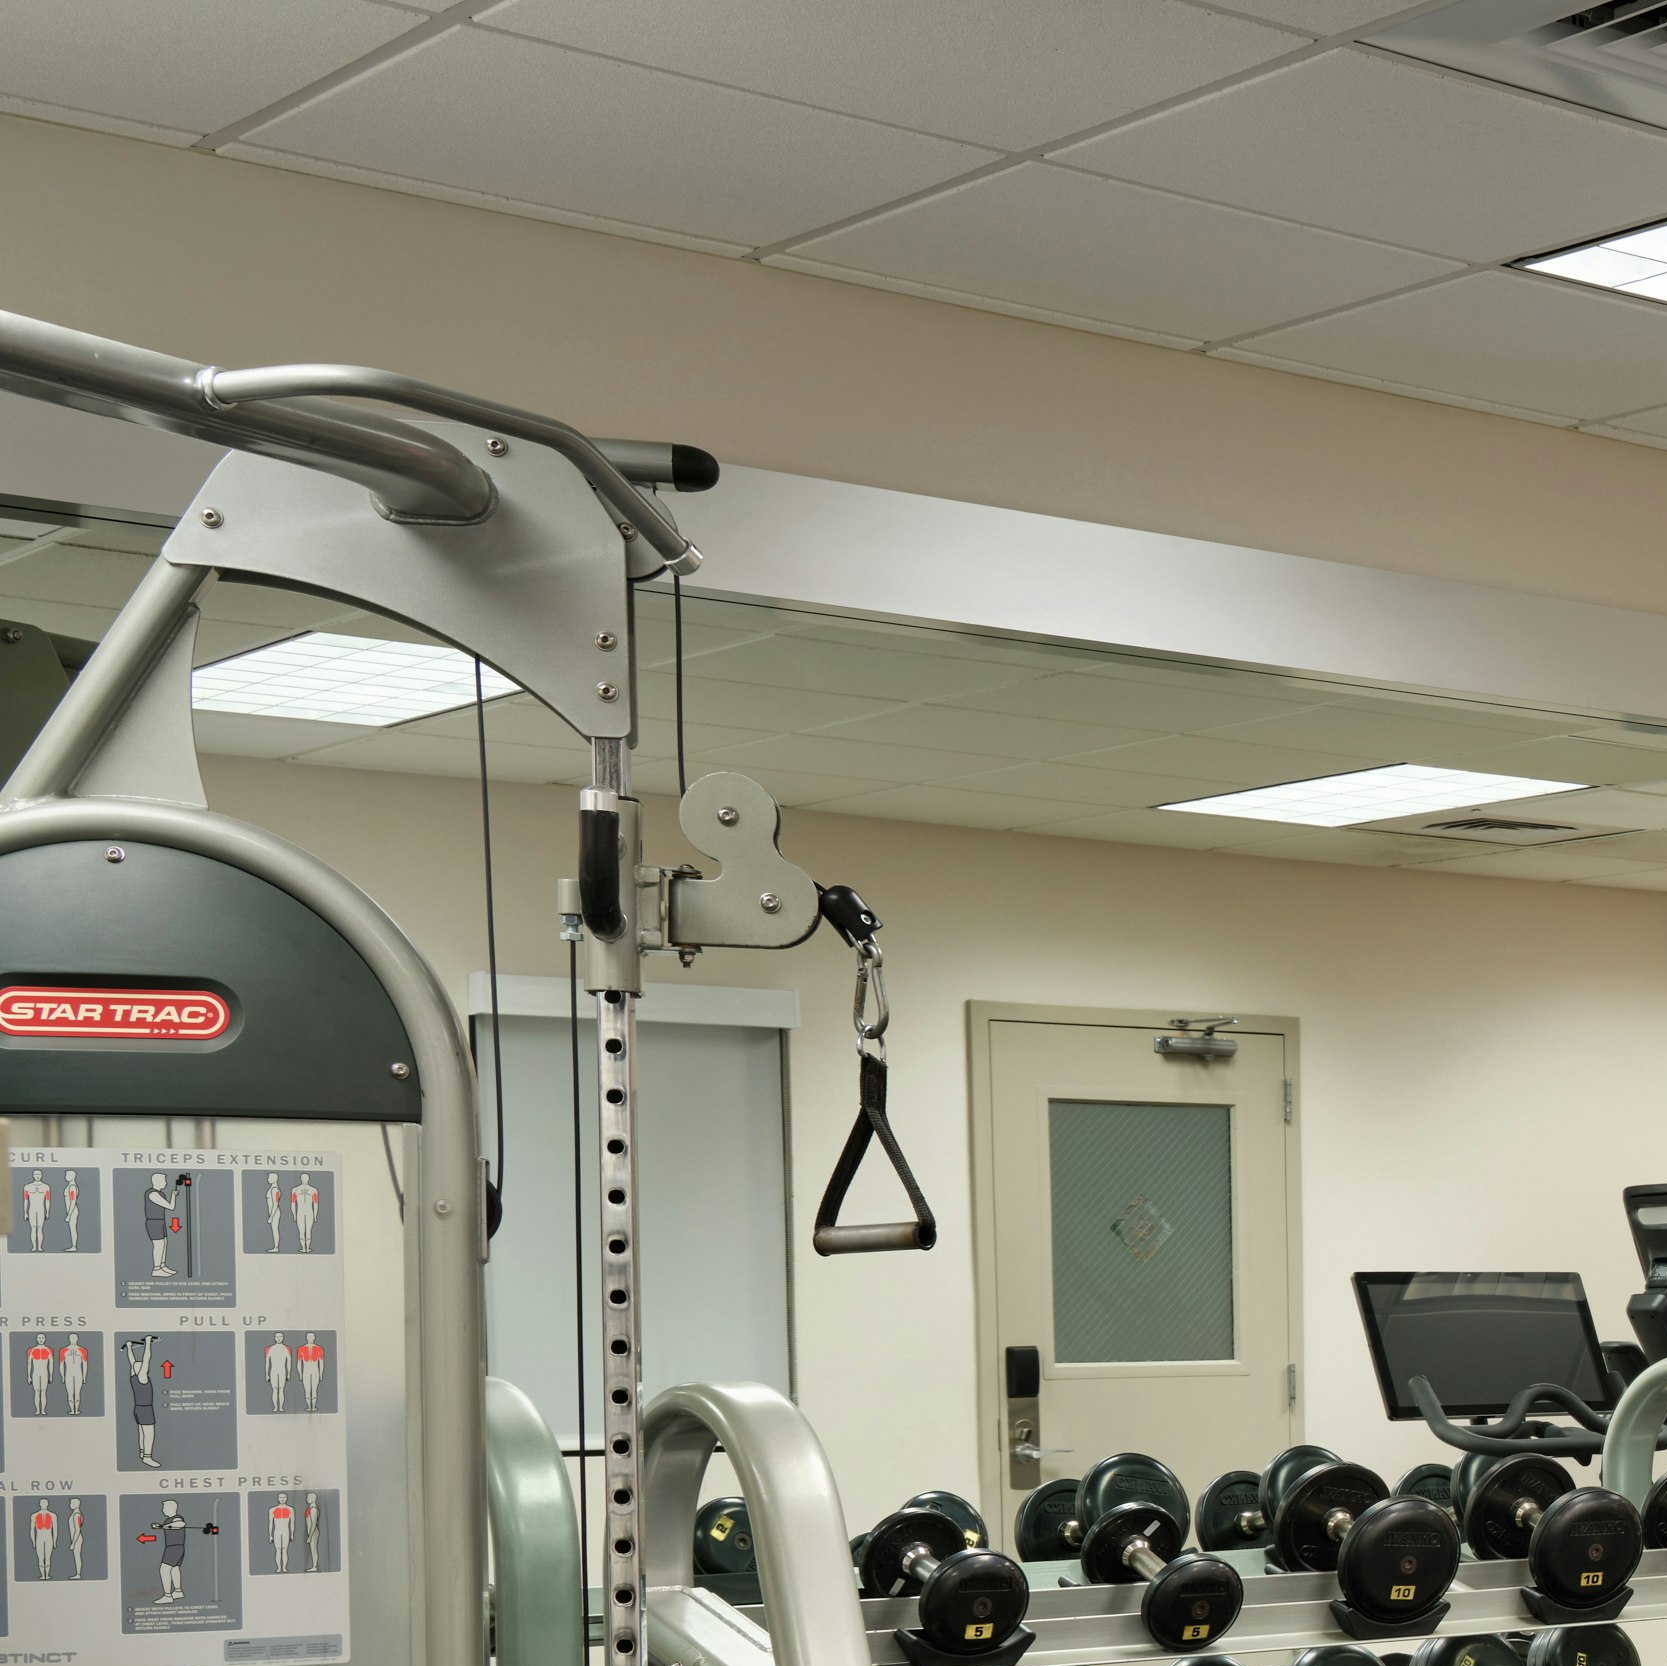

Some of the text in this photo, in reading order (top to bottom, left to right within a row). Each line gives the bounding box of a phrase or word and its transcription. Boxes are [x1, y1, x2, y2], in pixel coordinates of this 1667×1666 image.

[4, 1002, 207, 1023] STAR TRAC
[121, 1152, 325, 1167] TRICEPS EXTENSION
[22, 1316, 87, 1327] PRESS
[179, 1315, 268, 1327] PULL UP
[31, 1480, 73, 1491] ROW
[159, 1475, 304, 1489] CHEST PRESS
[1583, 1573, 1600, 1585] 10
[1394, 1587, 1412, 1599] 10
[975, 1626, 985, 1638] 5
[1191, 1626, 1202, 1638] 5
